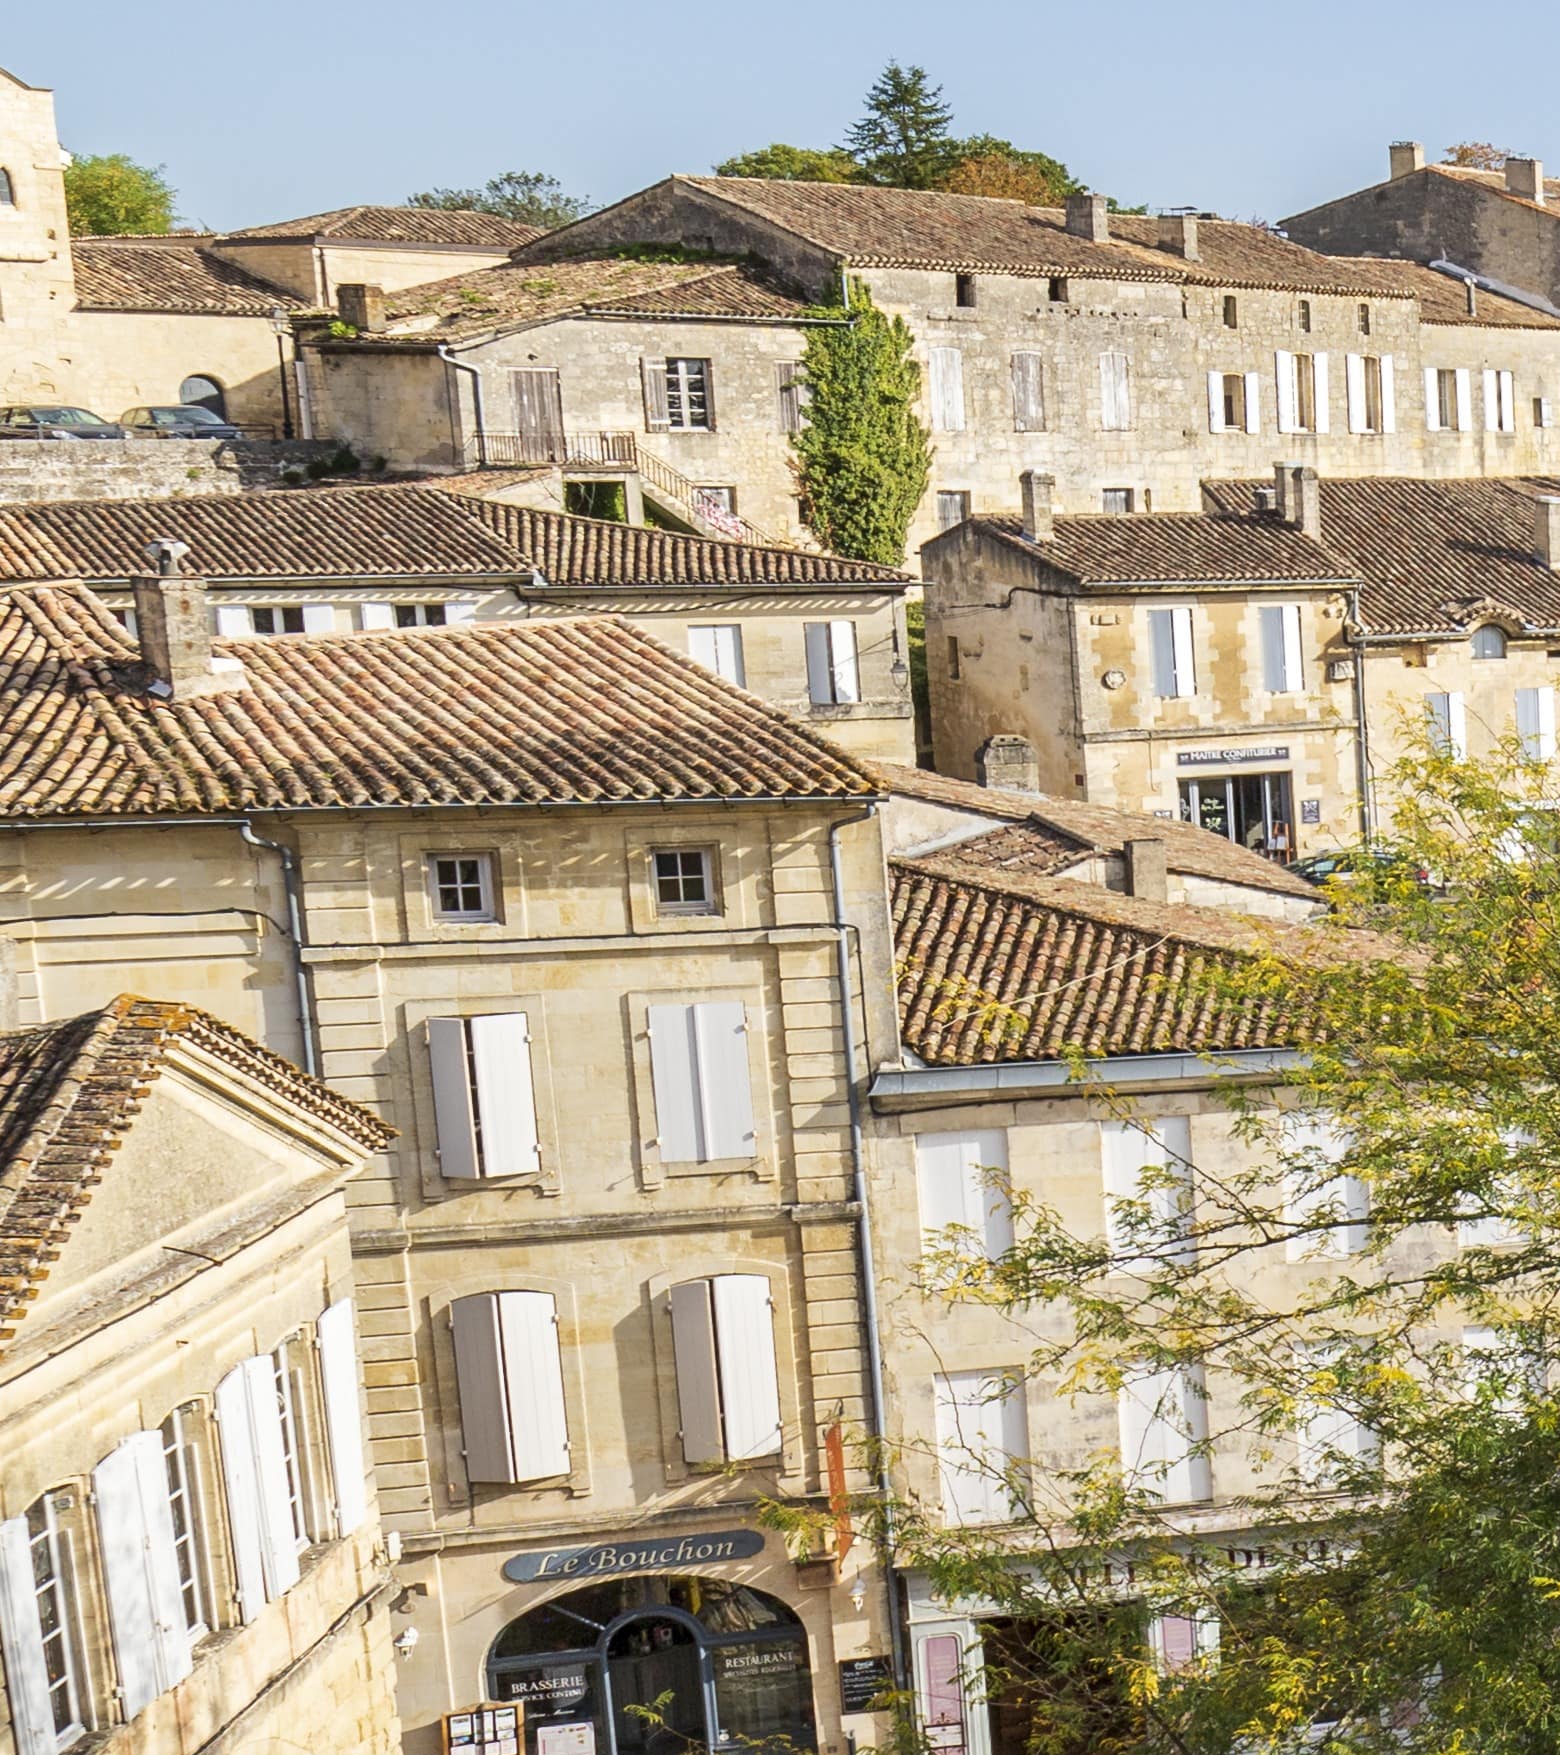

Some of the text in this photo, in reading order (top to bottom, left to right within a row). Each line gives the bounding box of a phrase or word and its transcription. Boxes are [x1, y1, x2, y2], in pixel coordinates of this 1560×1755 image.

[535, 1537, 733, 1577] Le Bouchon
[725, 1651, 793, 1669] RESTAURANT
[511, 1676, 584, 1694] BRASSERIE
